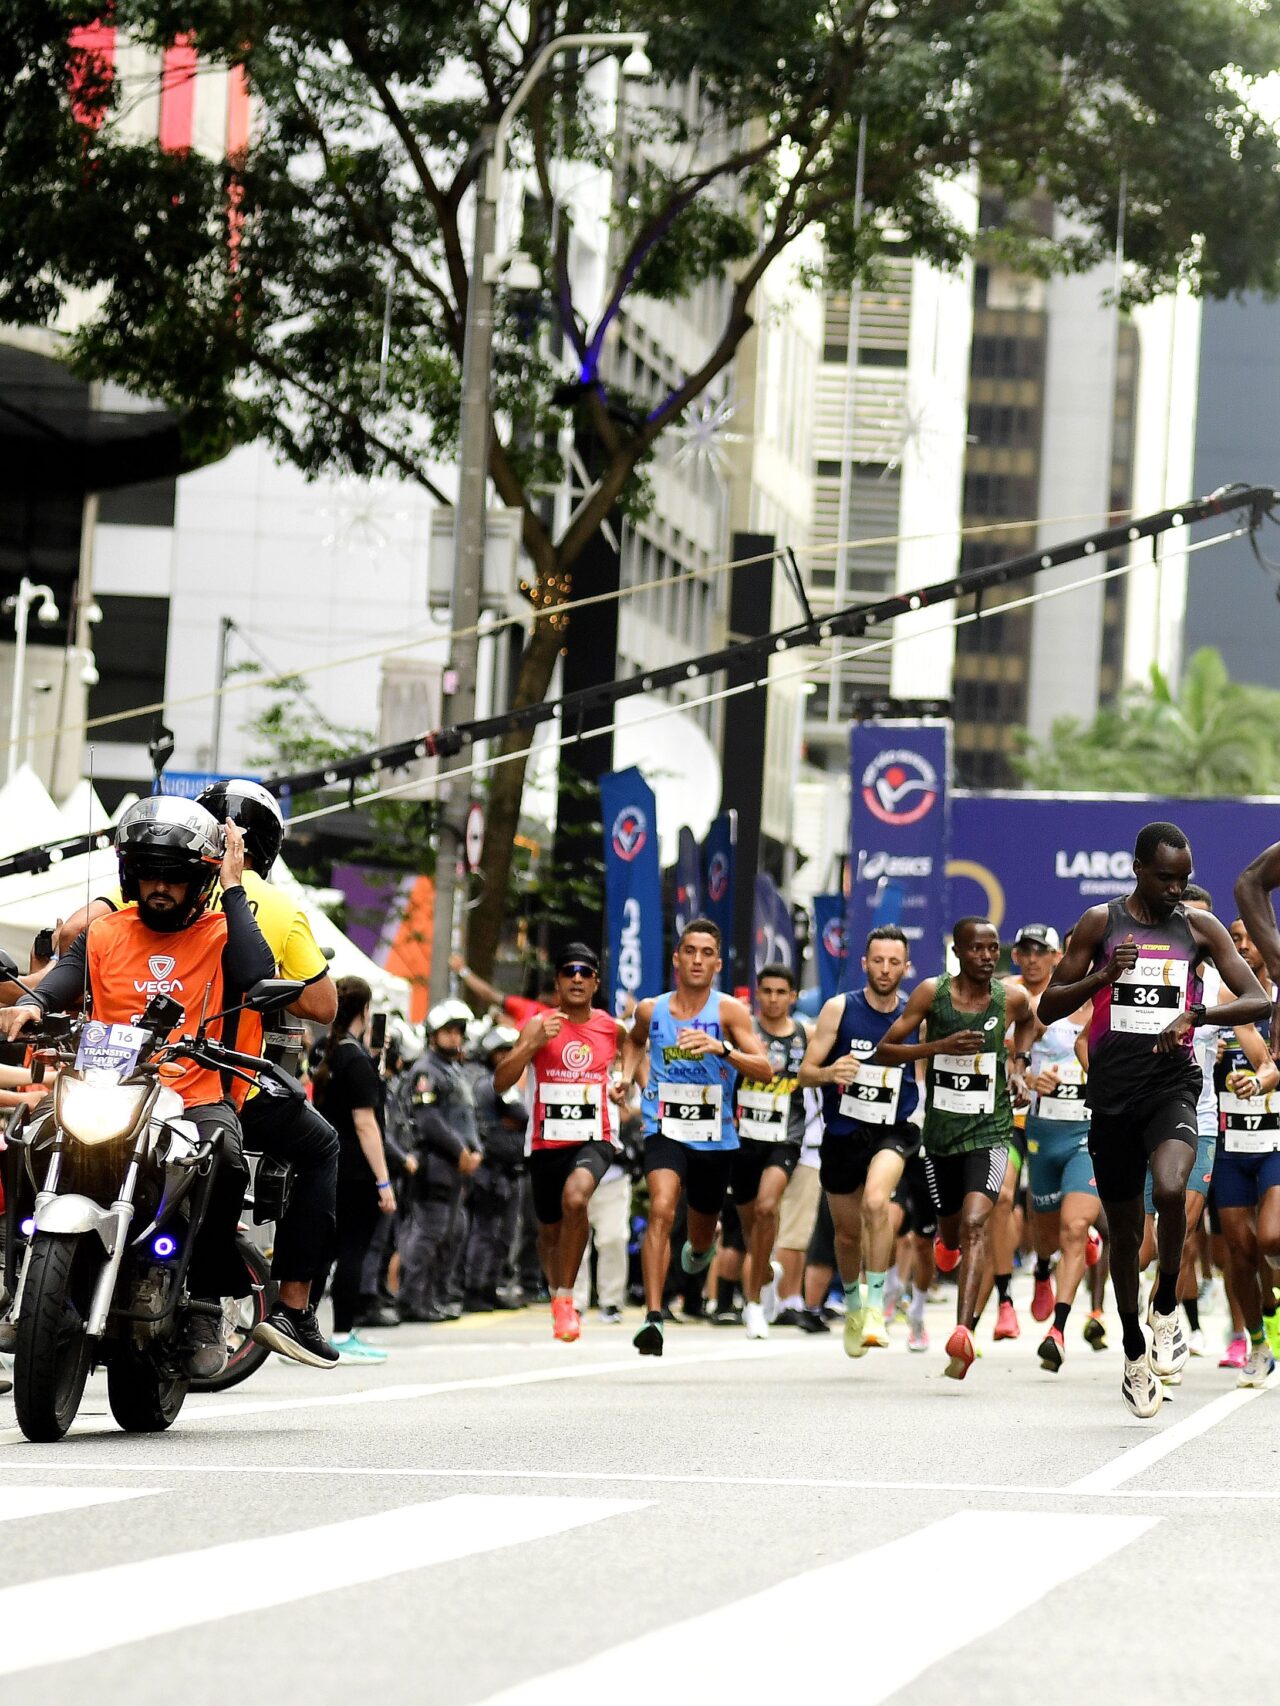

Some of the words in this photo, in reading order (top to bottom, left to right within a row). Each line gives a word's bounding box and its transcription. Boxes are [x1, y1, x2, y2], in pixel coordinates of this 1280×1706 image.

[133, 979, 184, 993] VEGA
[1133, 987, 1160, 1005] 36
[117, 1031, 133, 1043] 16
[850, 1038, 873, 1050] ECO
[951, 1075, 971, 1090] 19
[857, 1085, 879, 1101] 29
[1057, 1084, 1079, 1099] 22
[560, 1104, 582, 1120] 96
[679, 1105, 700, 1120] 92
[1243, 1115, 1263, 1130] 17
